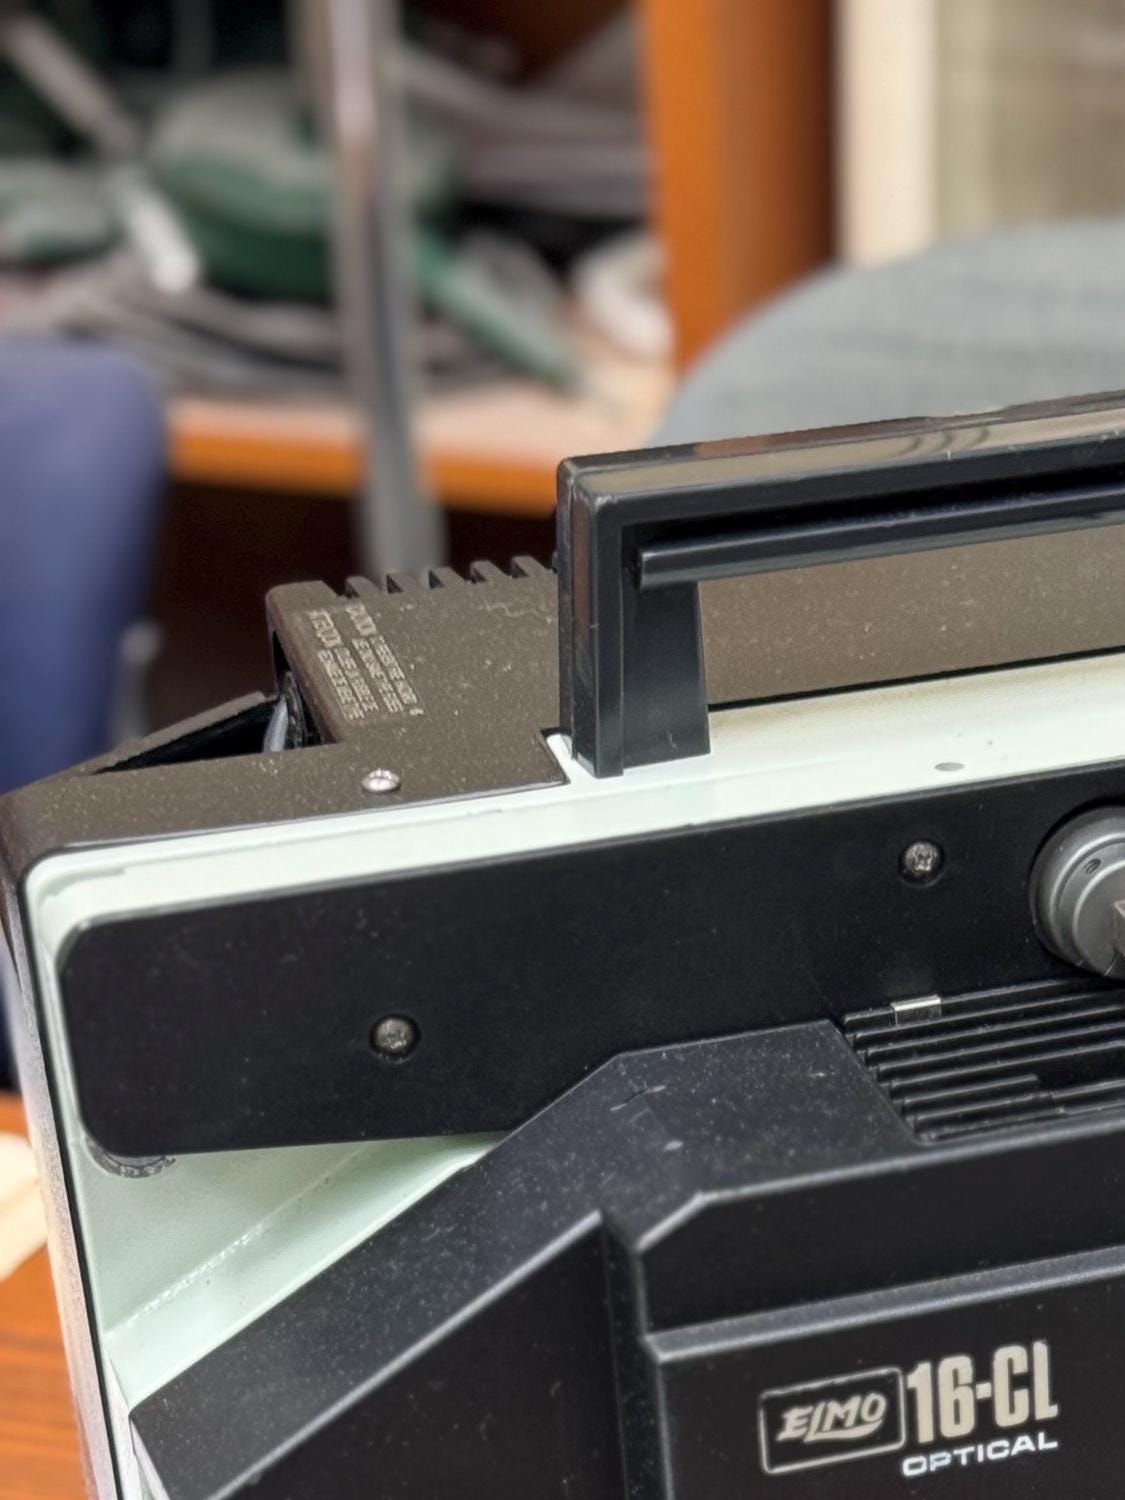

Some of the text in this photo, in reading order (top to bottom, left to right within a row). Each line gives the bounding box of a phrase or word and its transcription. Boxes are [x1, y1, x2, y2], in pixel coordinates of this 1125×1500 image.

[776, 1339, 1059, 1443] ELMO 16-CL
[903, 1432, 1059, 1477] OPTICAL
